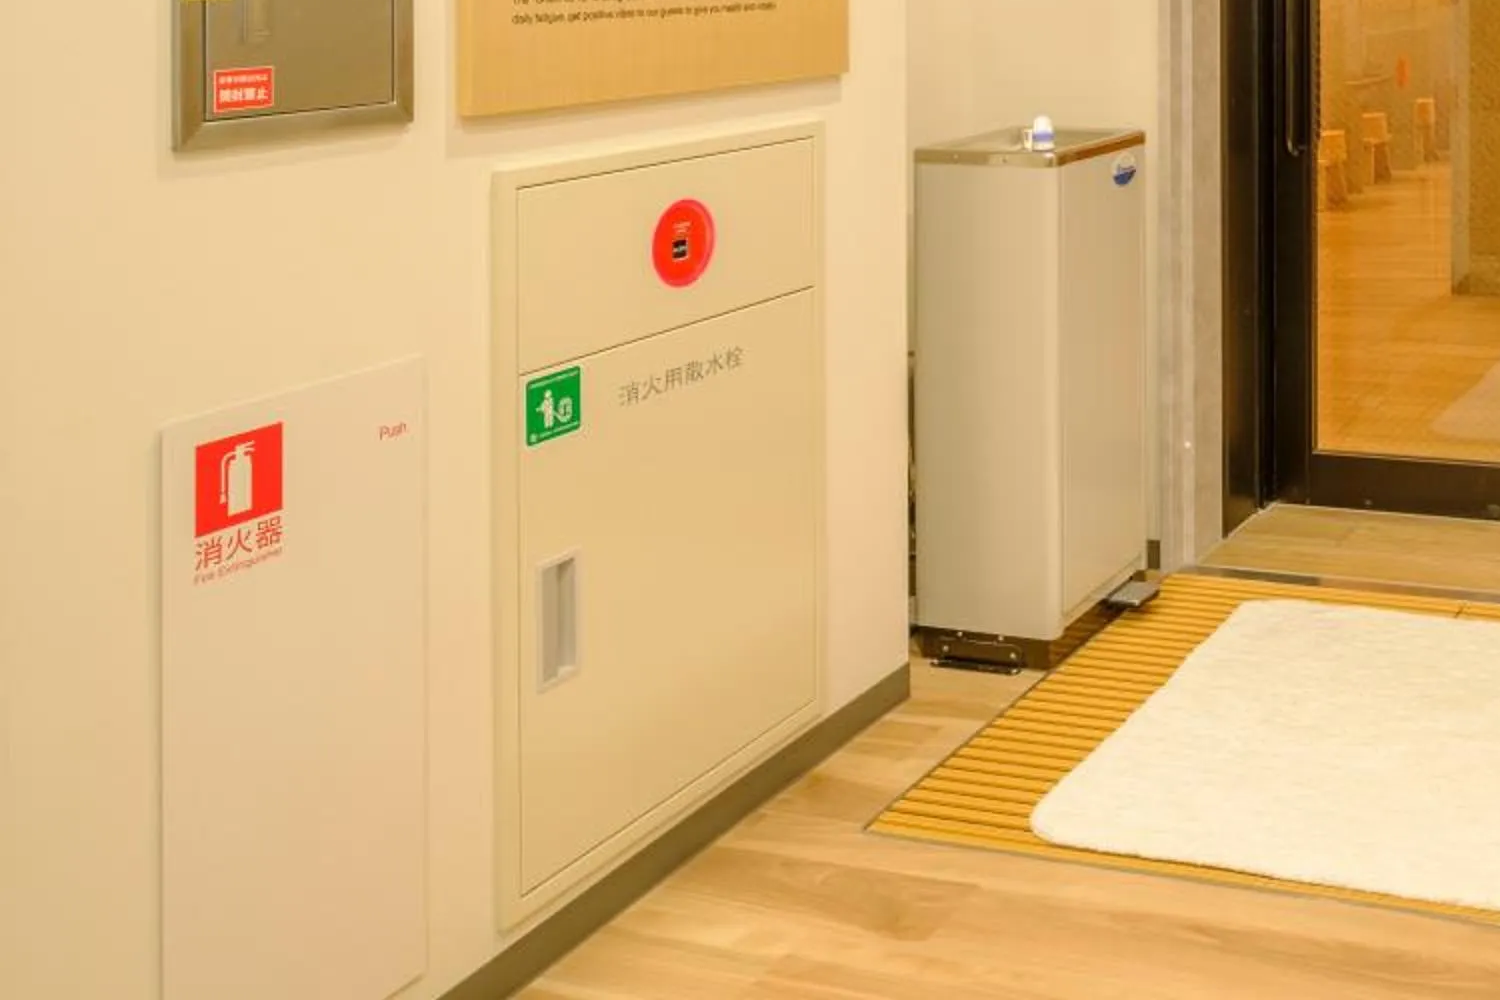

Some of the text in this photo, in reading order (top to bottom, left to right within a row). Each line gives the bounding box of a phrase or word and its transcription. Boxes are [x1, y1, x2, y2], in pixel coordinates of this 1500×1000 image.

[617, 345, 744, 407] 消火用散水栓
[379, 422, 407, 441] Push
[195, 515, 283, 572] 消火器
